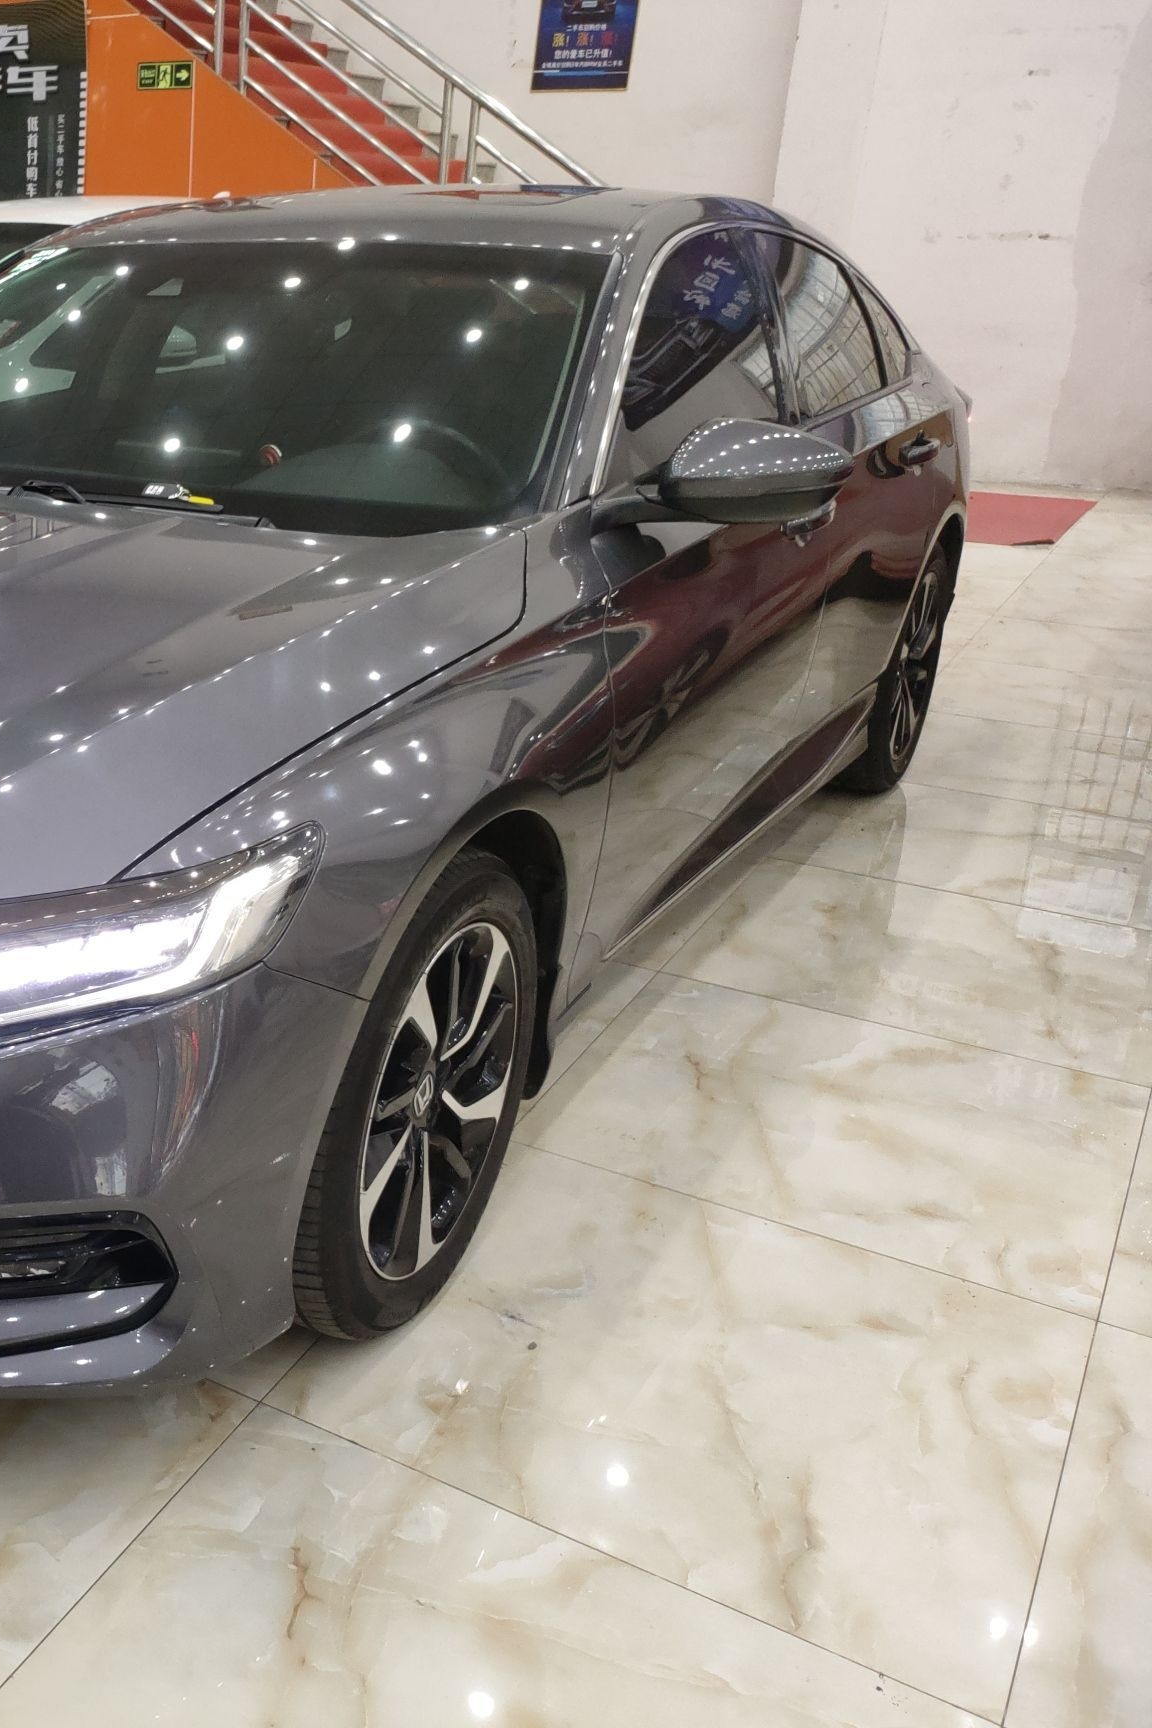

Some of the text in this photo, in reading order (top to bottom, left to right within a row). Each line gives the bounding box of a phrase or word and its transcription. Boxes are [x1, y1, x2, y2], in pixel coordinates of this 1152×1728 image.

[26, 116, 39, 198] 低首付购车
